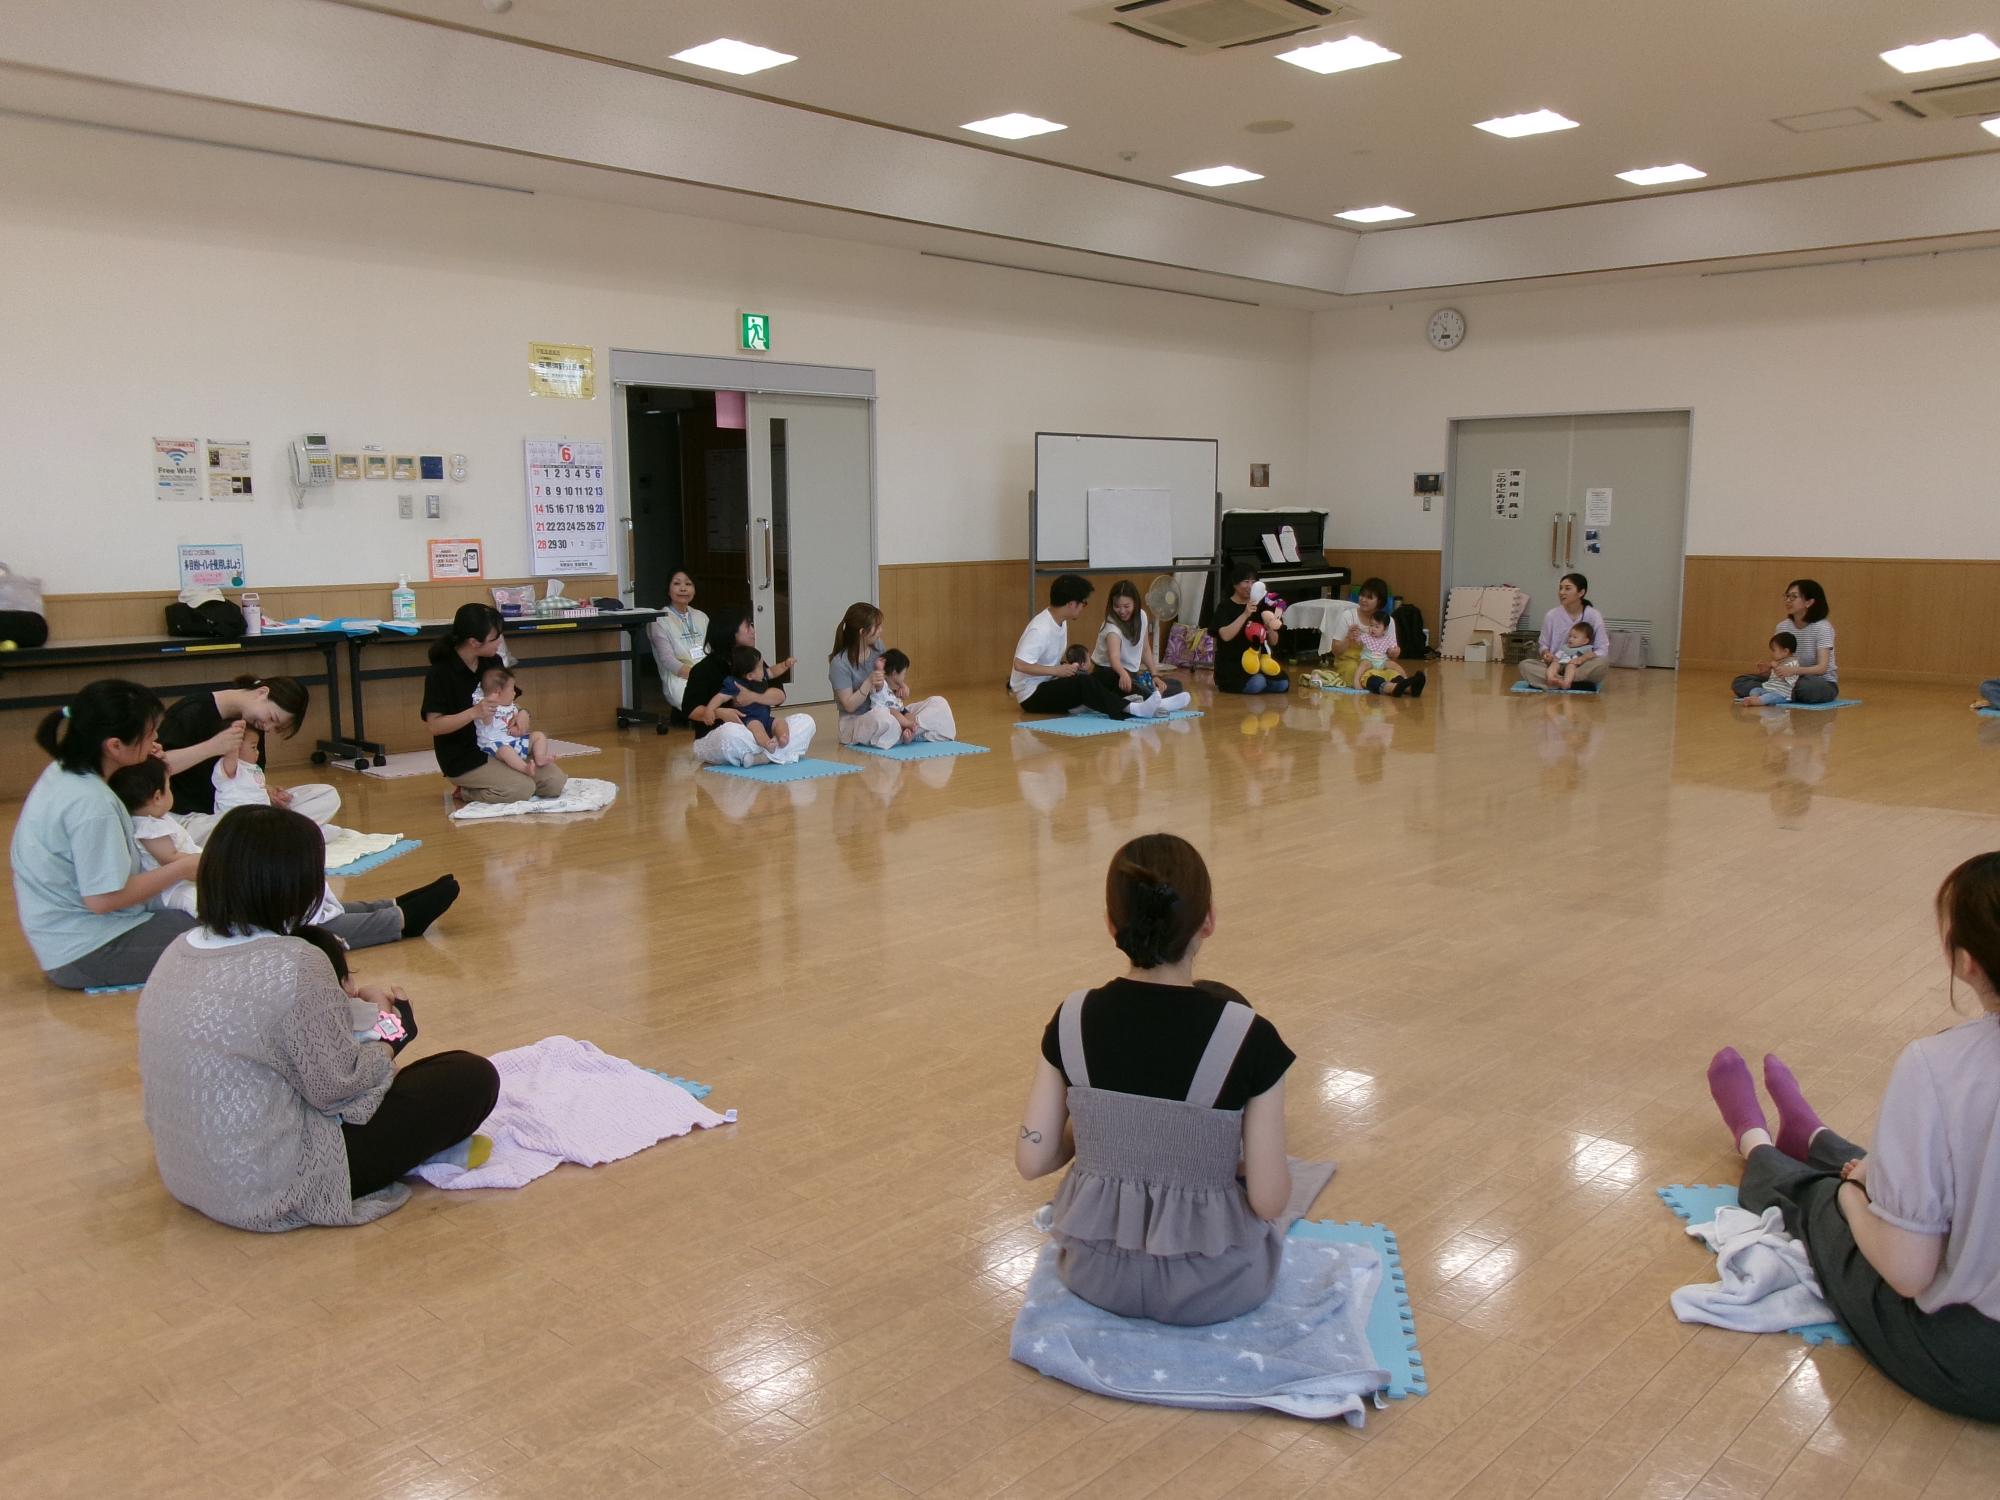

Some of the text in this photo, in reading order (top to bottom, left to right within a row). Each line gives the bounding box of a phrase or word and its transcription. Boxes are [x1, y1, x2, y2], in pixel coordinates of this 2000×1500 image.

[561, 448, 571, 462] 6
[544, 469, 549, 478] 1
[555, 469, 560, 478] 2
[565, 469, 570, 478] 3
[575, 469, 580, 478] 4
[585, 469, 591, 478] 5
[595, 469, 601, 478] 6
[535, 486, 603, 496] 7 8 9 10 11 12 13
[535, 504, 604, 513] 14 15 16 17 18 19 20
[536, 522, 605, 531] 21 22 23 24 25 26 27
[537, 540, 546, 549] 28
[548, 540, 557, 549] 29
[558, 540, 567, 549] 30
